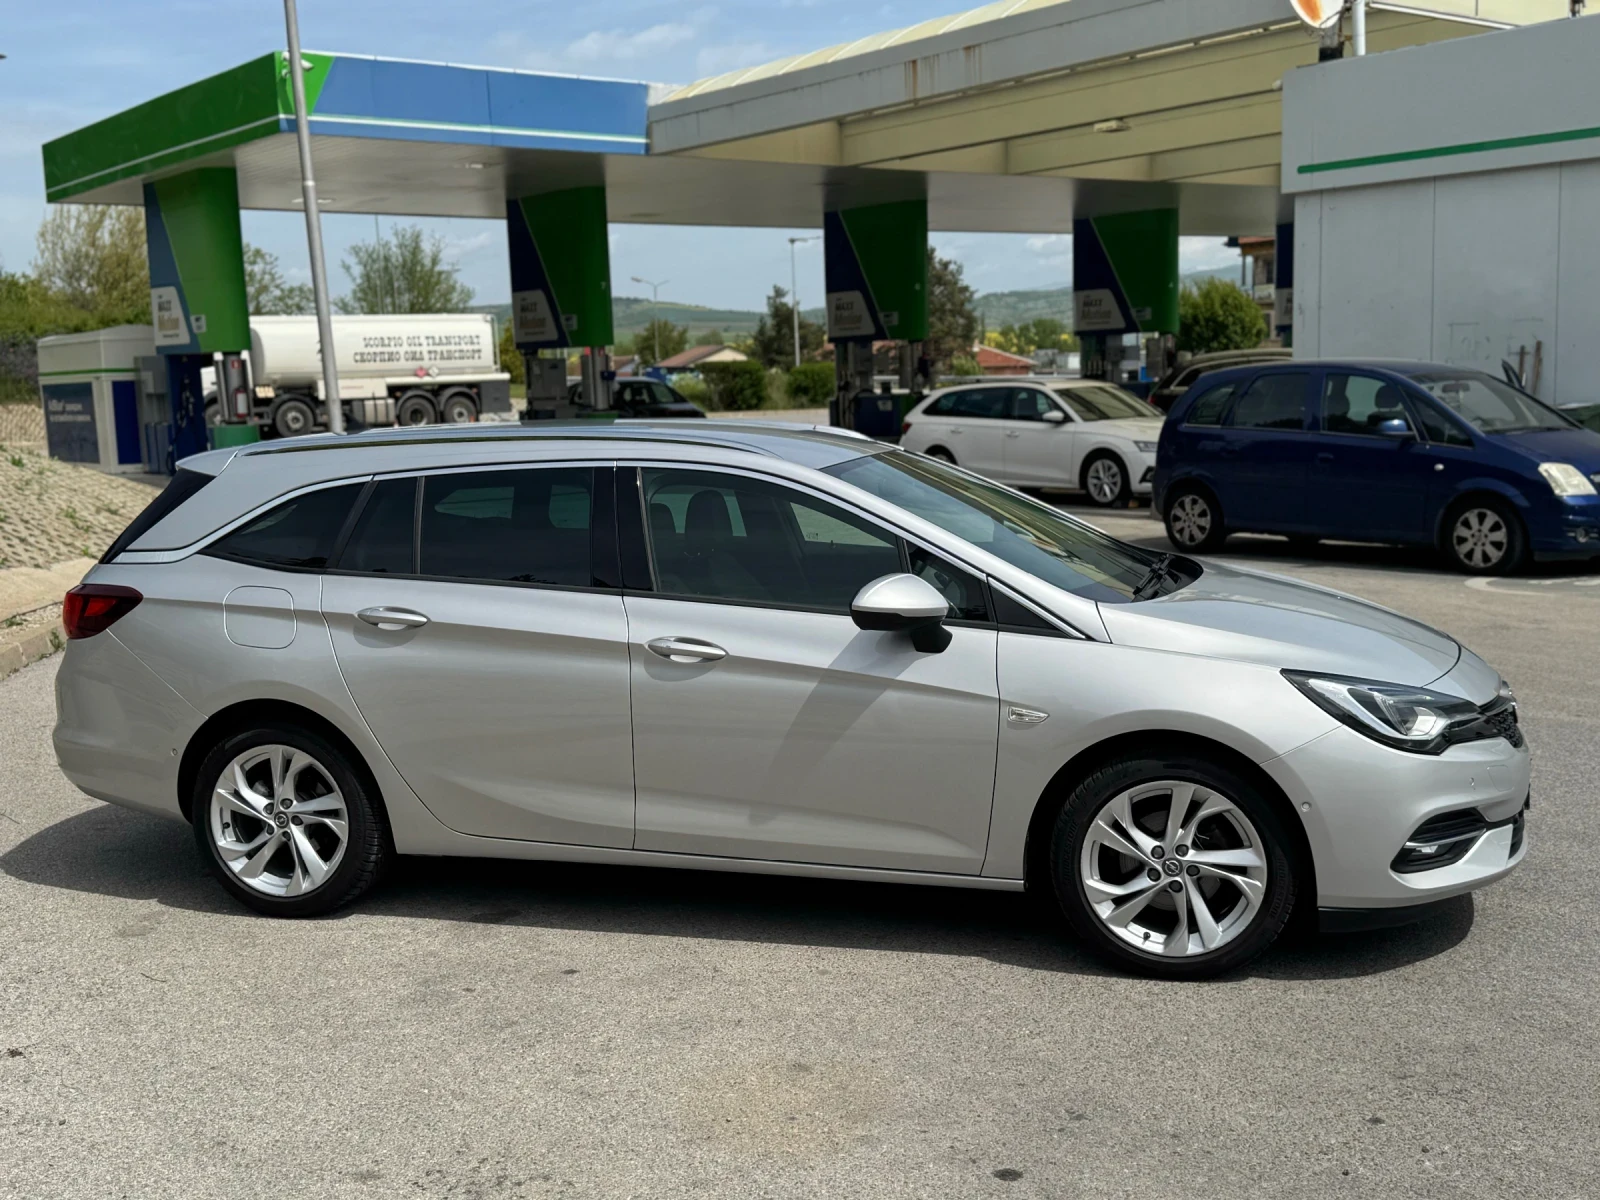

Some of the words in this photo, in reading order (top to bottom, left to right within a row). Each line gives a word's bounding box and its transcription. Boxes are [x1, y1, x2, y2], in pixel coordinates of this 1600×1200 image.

[363, 336, 403, 348] SCORPIO
[406, 336, 422, 347] OIL
[425, 335, 481, 347] TRANSPORT
[353, 351, 401, 363] СКОРПИО
[427, 349, 482, 361] ТРАНСПОРТ
